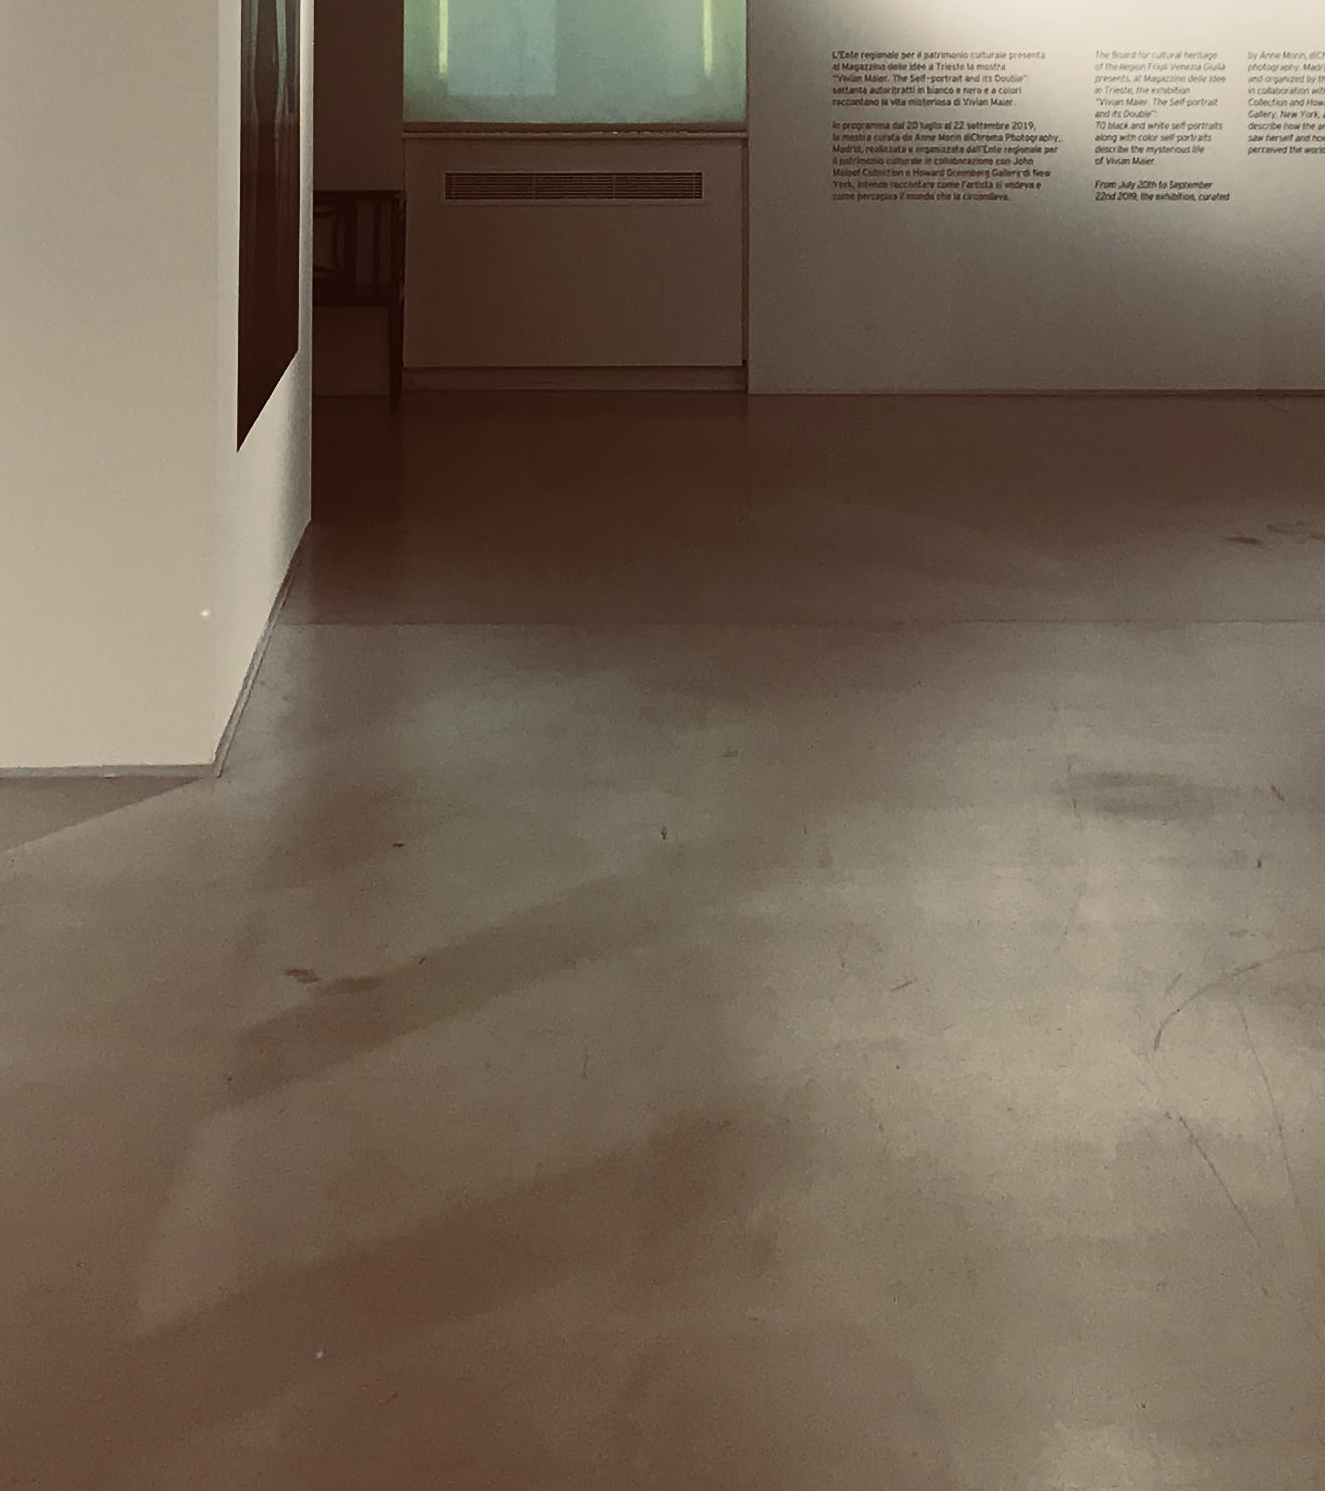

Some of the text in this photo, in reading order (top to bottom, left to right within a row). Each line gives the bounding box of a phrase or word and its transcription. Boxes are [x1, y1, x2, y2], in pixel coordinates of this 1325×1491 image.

[900, 51, 915, 60] per
[924, 51, 968, 60] patrimonio
[970, 51, 1006, 60] culturale
[1009, 51, 1045, 60] presenta
[1096, 51, 1110, 60] The
[1112, 51, 1136, 60] Board
[1151, 51, 1182, 60] cultural
[1184, 51, 1218, 60] heritage
[1260, 51, 1280, 60] Anne
[936, 62, 964, 71] Trieste
[966, 62, 974, 71] la
[976, 62, 1006, 71] mostra
[892, 74, 907, 83] The
[910, 74, 962, 83] Self-portrait
[965, 74, 980, 83] and
[982, 74, 992, 83] its
[1248, 75, 1263, 84] and
[964, 86, 982, 95] nero
[998, 86, 1022, 95] colori
[1152, 86, 1191, 95] exhibition
[963, 98, 988, 107] Vivian
[1153, 98, 1168, 107] The
[1290, 98, 1304, 107] and
[1094, 110, 1110, 118] and
[906, 122, 918, 130] 20
[954, 122, 964, 130] 22
[1012, 122, 1036, 130] 2019,
[1096, 121, 1106, 130] 70
[1108, 121, 1128, 130] black
[1130, 121, 1146, 130] and
[1148, 121, 1170, 130] white
[1248, 122, 1282, 130] describe
[1284, 122, 1300, 130] how
[1302, 122, 1316, 130] the
[1094, 134, 1118, 143] along
[1120, 133, 1136, 142] with
[1138, 133, 1158, 142] color
[1248, 134, 1263, 142] saw
[1265, 134, 1294, 142] herself
[1295, 134, 1311, 142] and
[1130, 145, 1144, 154] the
[1248, 146, 1288, 155] perceived
[1290, 146, 1303, 155] the
[1094, 157, 1104, 165] of
[1095, 180, 1116, 190] From
[1118, 180, 1136, 190] July
[1158, 180, 1168, 190] to
[1170, 180, 1212, 190] September
[1095, 192, 1116, 201] 22nd
[1140, 192, 1154, 201] the
[1198, 192, 1230, 201] curated
